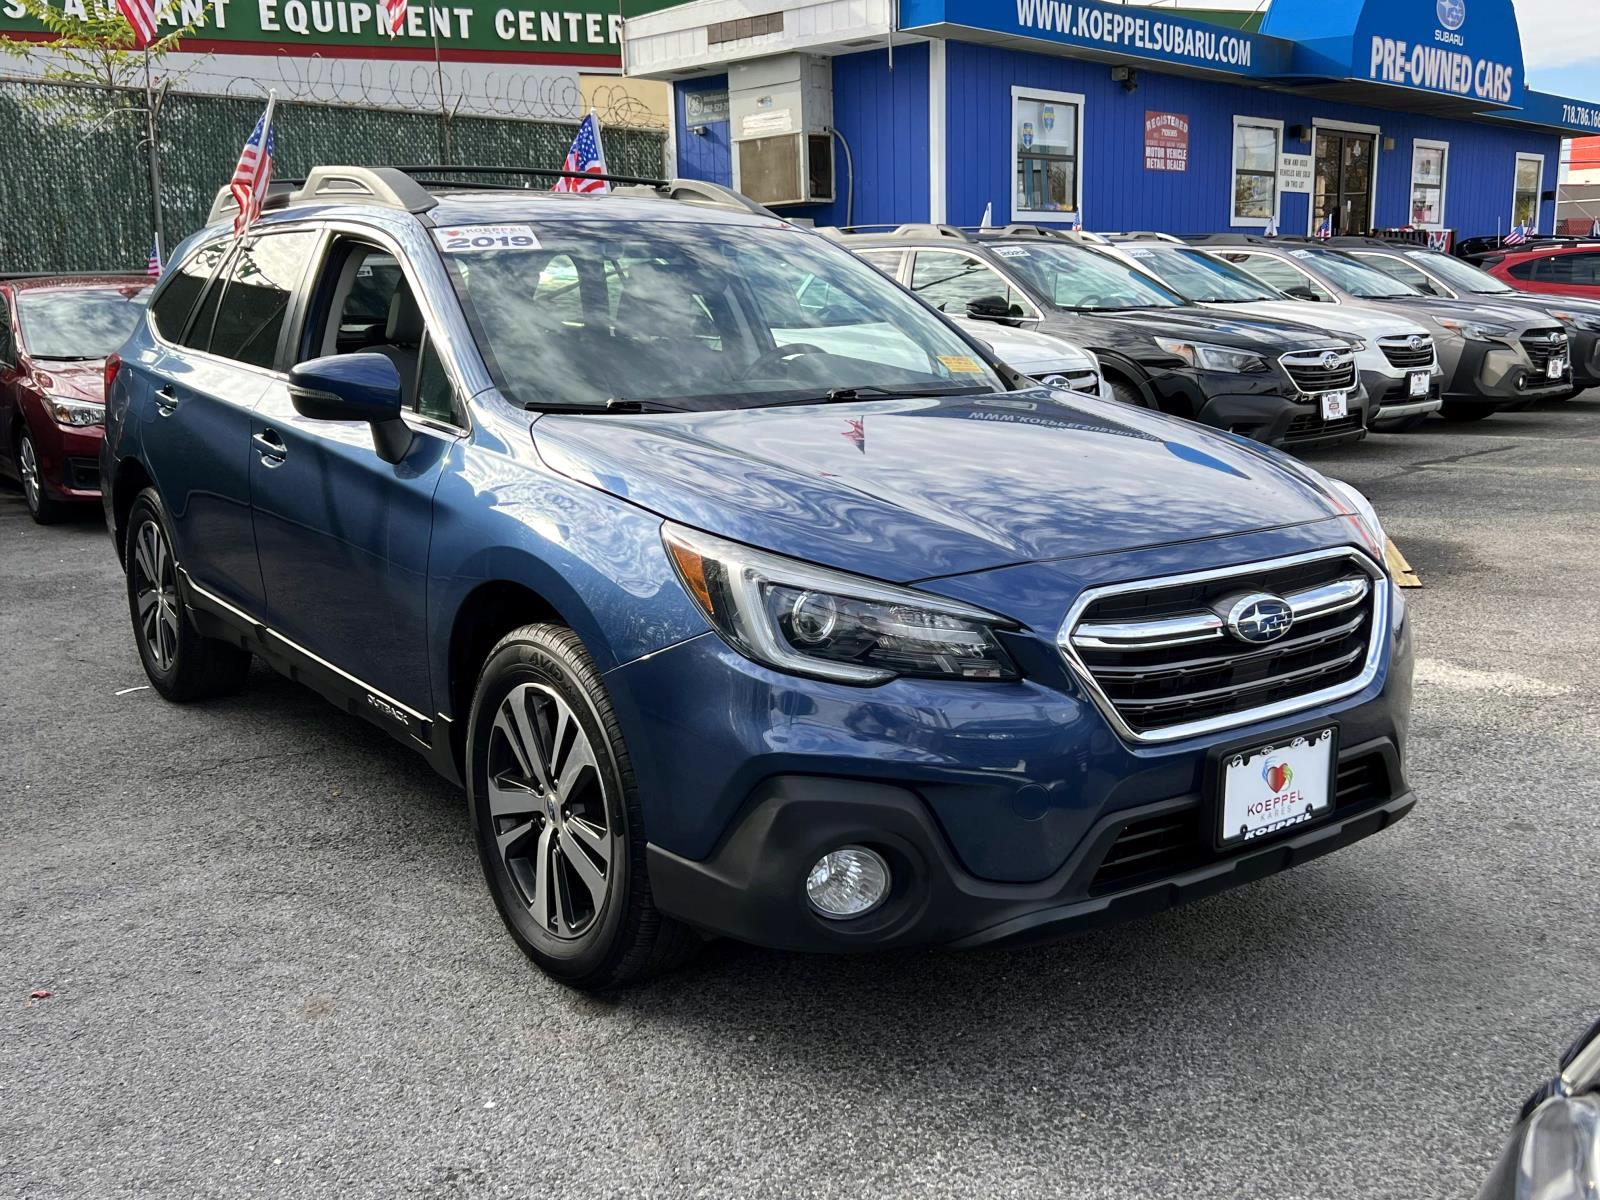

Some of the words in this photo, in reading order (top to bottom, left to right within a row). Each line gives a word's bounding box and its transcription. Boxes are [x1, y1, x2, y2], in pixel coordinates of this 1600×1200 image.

[260, 0, 473, 39] EQUIPMENT
[495, 9, 622, 44] CENTER
[1016, 0, 1251, 67] WWW.KOEPPELSUBARU.COM
[1434, 29, 1464, 46] SUBARU
[1370, 35, 1473, 95] PRE-OWNED
[1474, 58, 1512, 103] CARS
[1146, 114, 1188, 133] REGISTERED
[1145, 146, 1165, 158] MOTOR
[1166, 148, 1187, 160] VEHICLE
[1146, 157, 1165, 169] RETAIL
[1166, 159, 1186, 171] DEALER
[446, 235, 534, 249] 2019
[1247, 789, 1304, 817] KOEPPEL
[1260, 805, 1293, 821] KARES
[1244, 813, 1312, 840] KOEPPEL
